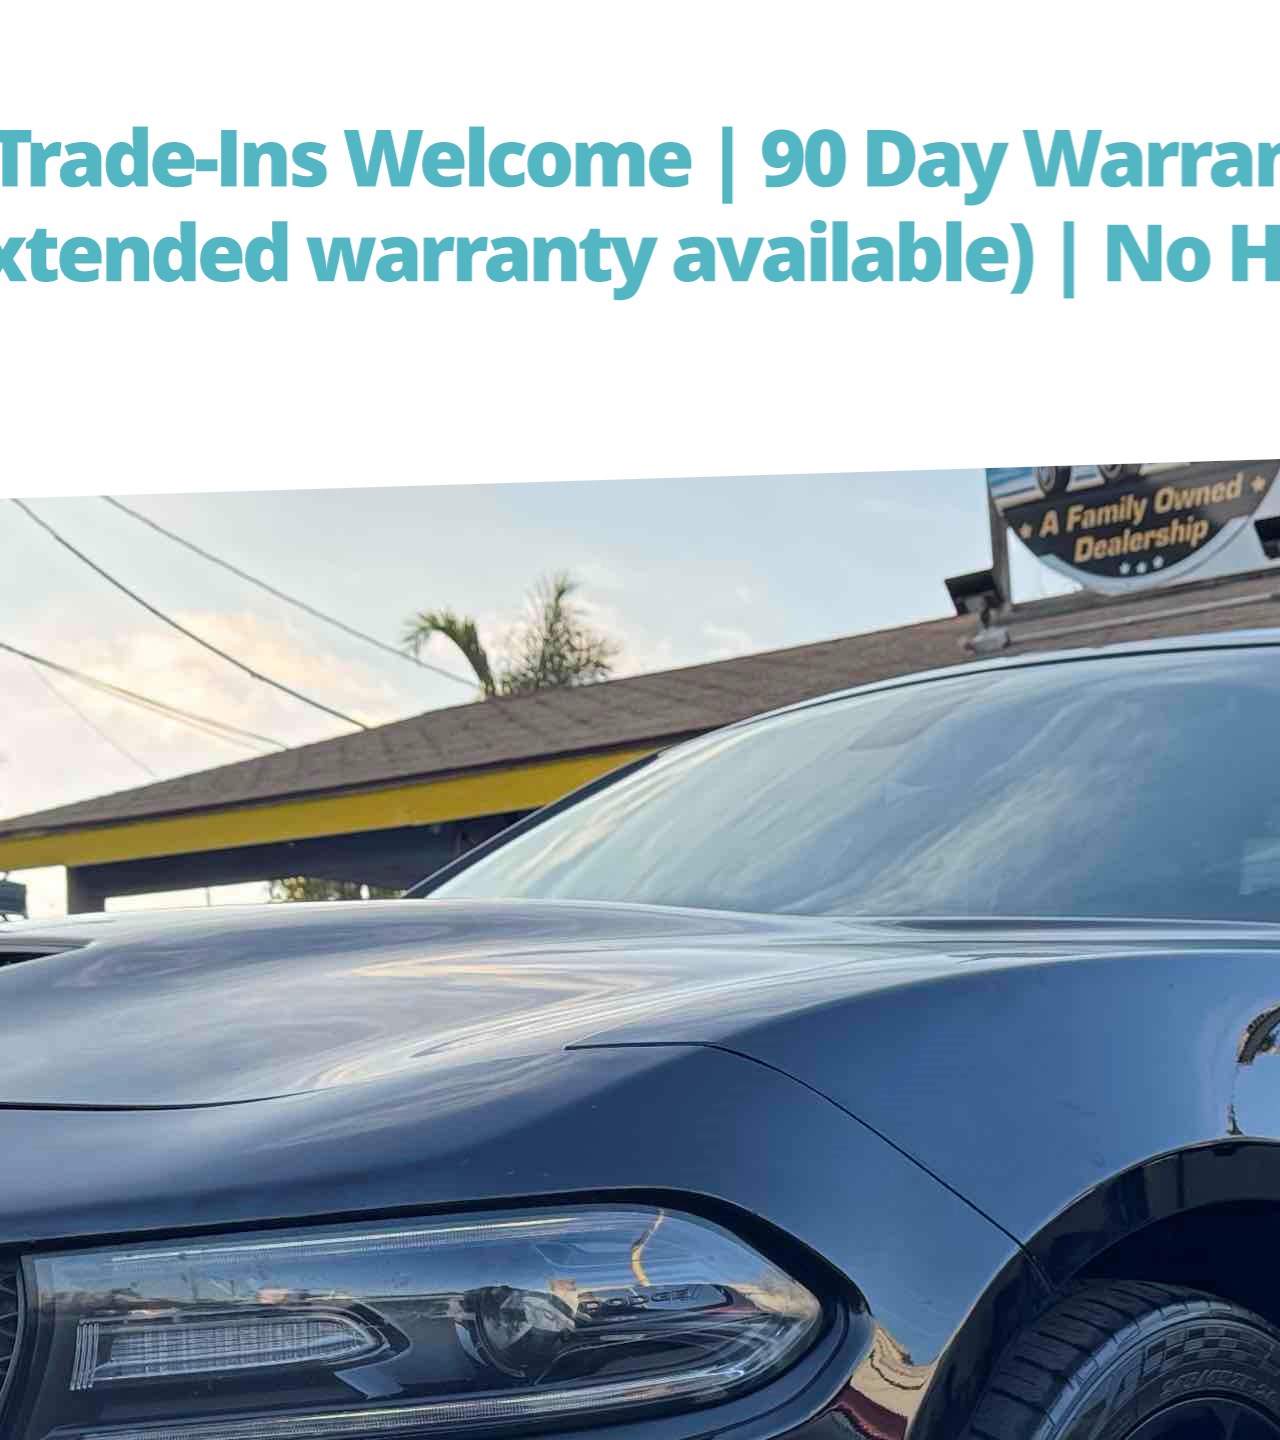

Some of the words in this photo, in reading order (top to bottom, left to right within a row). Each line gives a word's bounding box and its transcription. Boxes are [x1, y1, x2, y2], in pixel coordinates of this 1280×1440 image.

[1039, 510, 1059, 537] A
[1066, 494, 1147, 540] Family
[1154, 472, 1243, 513] Owned
[1074, 517, 1210, 563] Dealership
